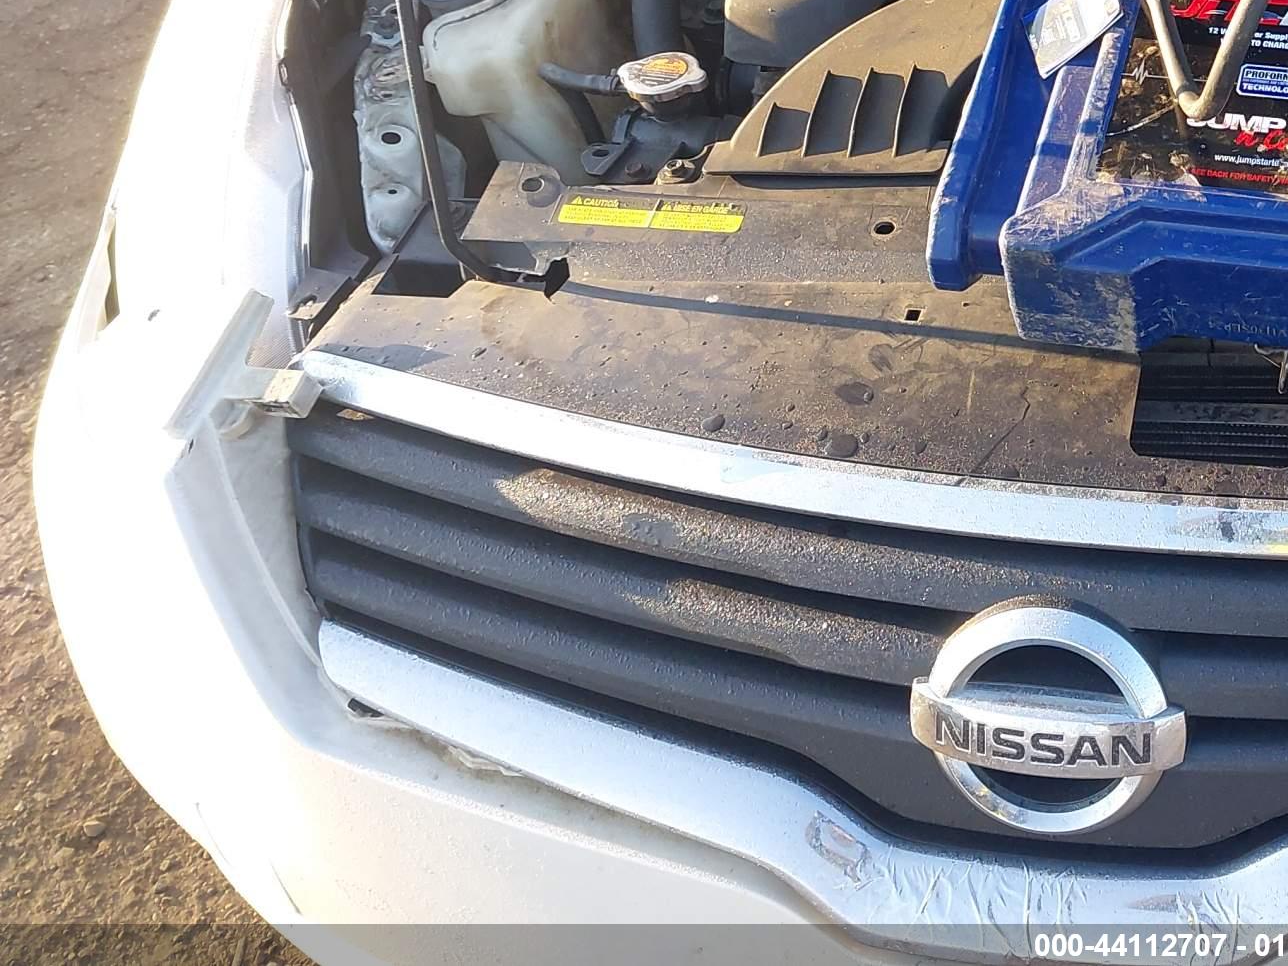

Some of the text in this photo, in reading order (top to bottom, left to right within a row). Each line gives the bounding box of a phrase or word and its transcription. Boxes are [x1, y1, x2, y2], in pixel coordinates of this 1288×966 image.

[1207, 169, 1228, 178] BACK
[1247, 173, 1277, 183] SAFETY
[583, 198, 619, 208] CAUTION
[934, 712, 1153, 768] NISSAN
